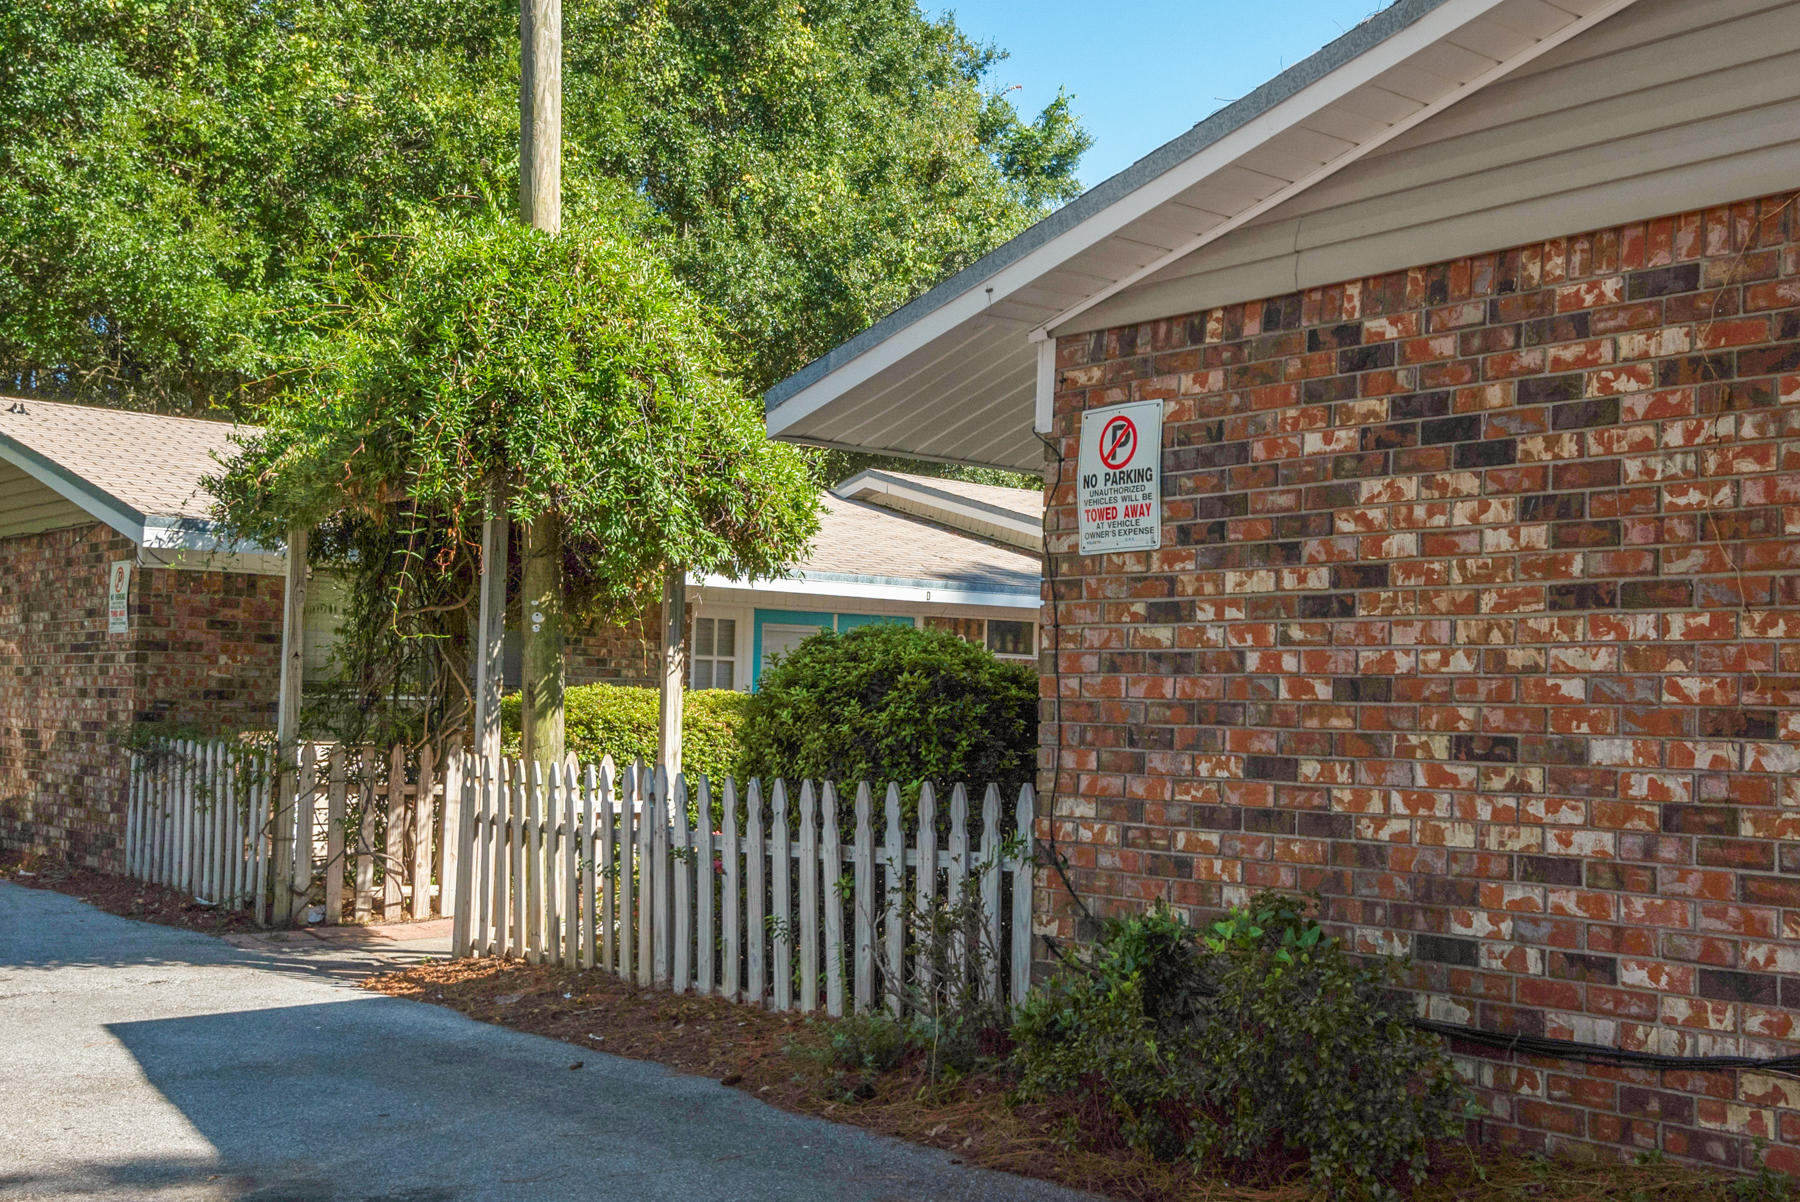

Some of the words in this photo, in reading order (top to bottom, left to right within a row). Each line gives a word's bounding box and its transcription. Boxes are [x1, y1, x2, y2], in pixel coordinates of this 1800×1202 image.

[1083, 474, 1098, 489] NO
[1104, 467, 1153, 486] PARKING
[1089, 484, 1146, 498] UNAUTHORIZED
[1084, 496, 1118, 506] VEHICLES
[1121, 494, 1139, 502] WILL
[1142, 492, 1152, 500] BE
[1085, 506, 1118, 522] TOWED
[1124, 502, 1152, 519] AWAY
[1108, 519, 1140, 528] VEHICLE
[1084, 530, 1116, 540] OWNER'S
[1118, 526, 1154, 536] EXPENSE
